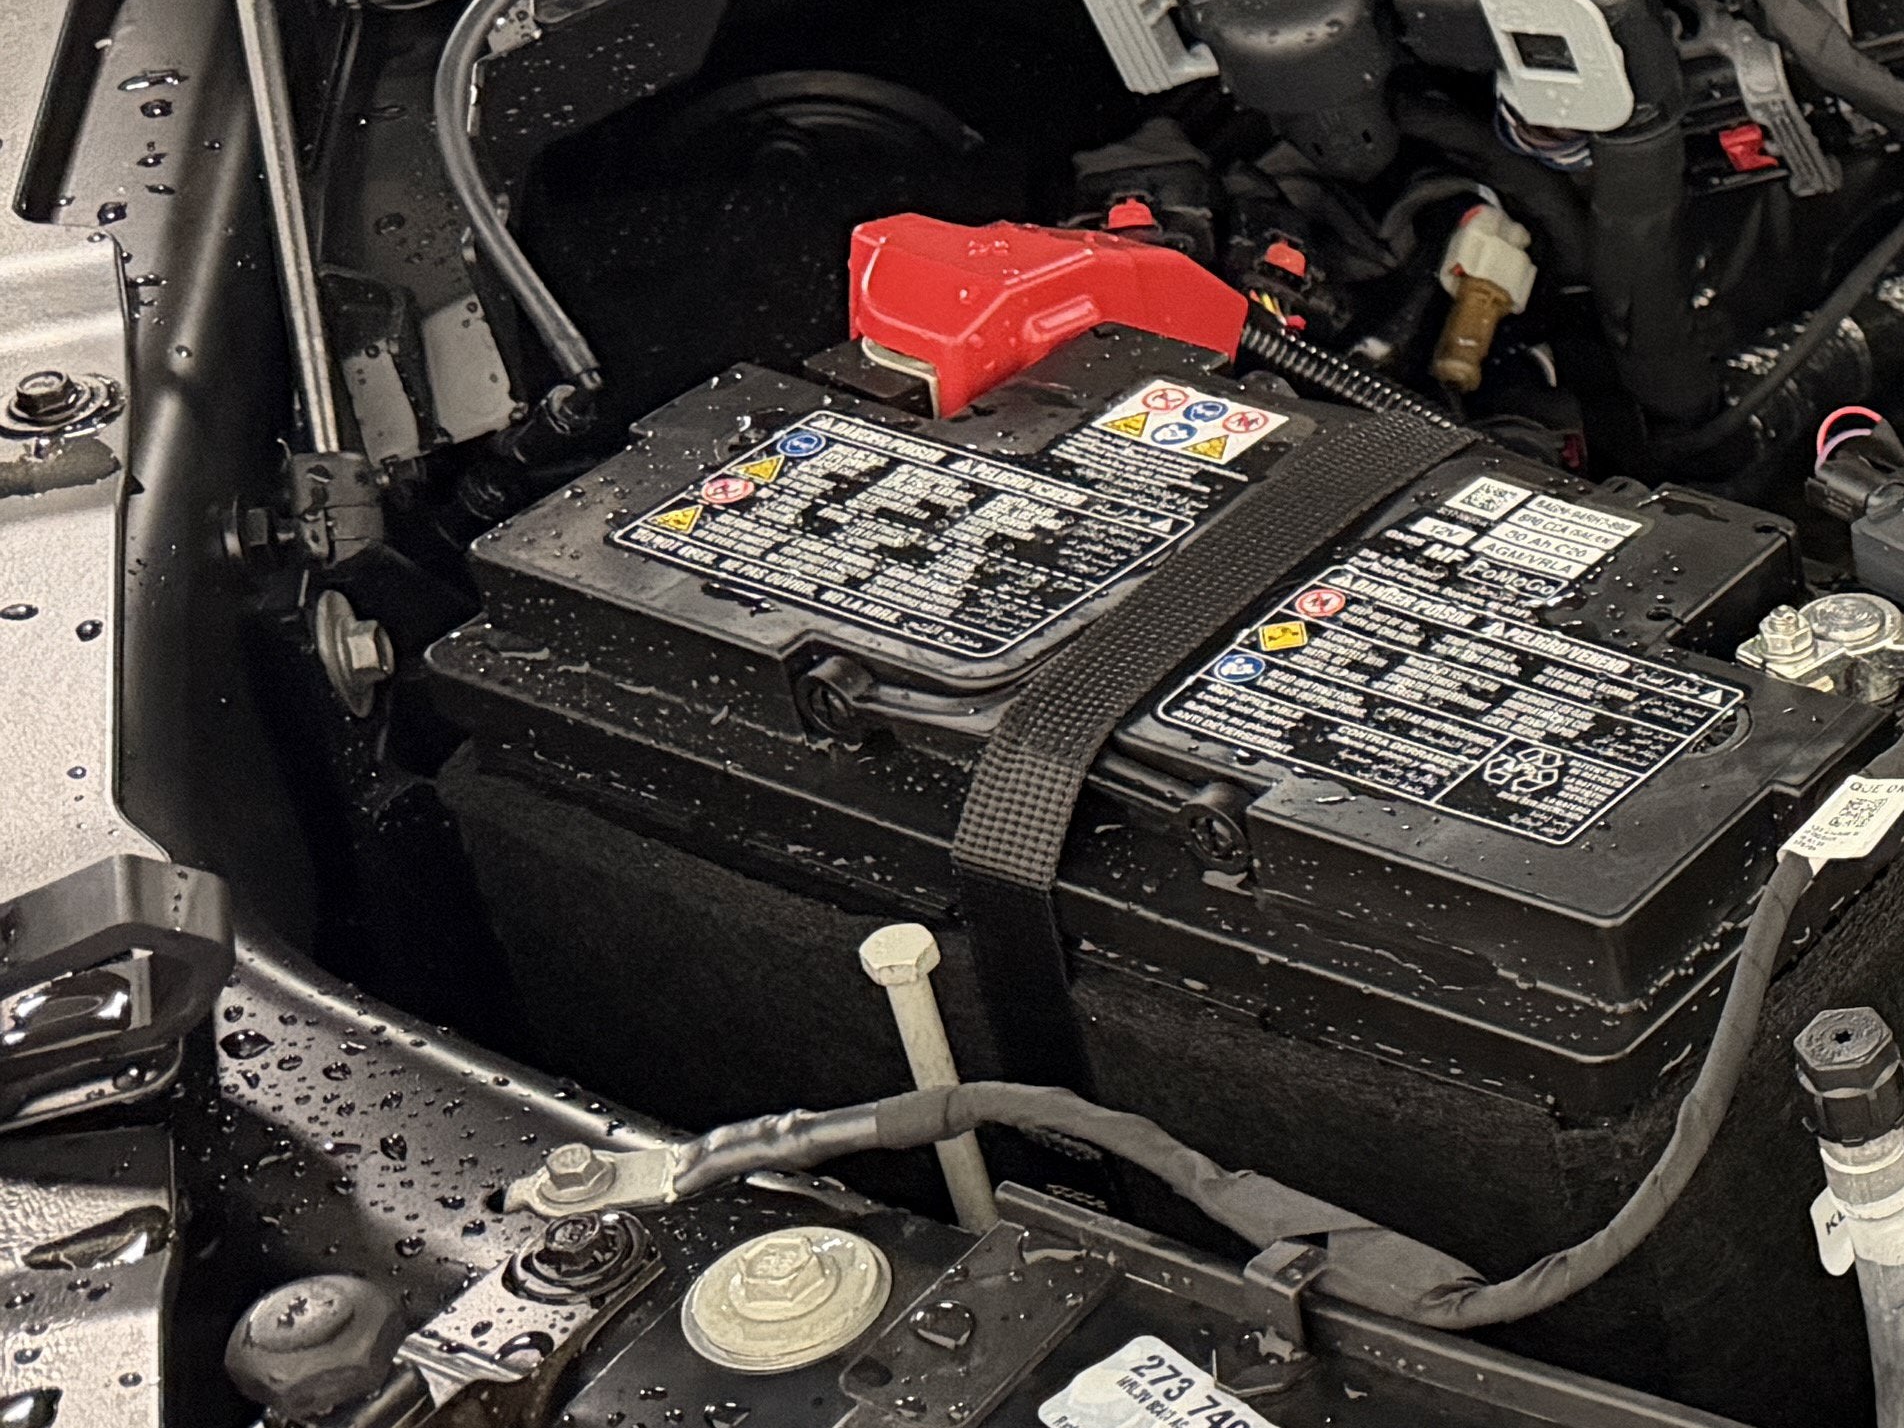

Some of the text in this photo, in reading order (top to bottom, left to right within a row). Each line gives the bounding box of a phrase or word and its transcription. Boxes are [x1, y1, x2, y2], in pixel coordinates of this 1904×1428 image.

[1425, 523, 1462, 539] 12V
[1526, 536, 1554, 549] Ah
[1418, 541, 1473, 566] MF
[1481, 540, 1576, 576] AGM/VRLA
[1128, 1352, 1200, 1403] 273
